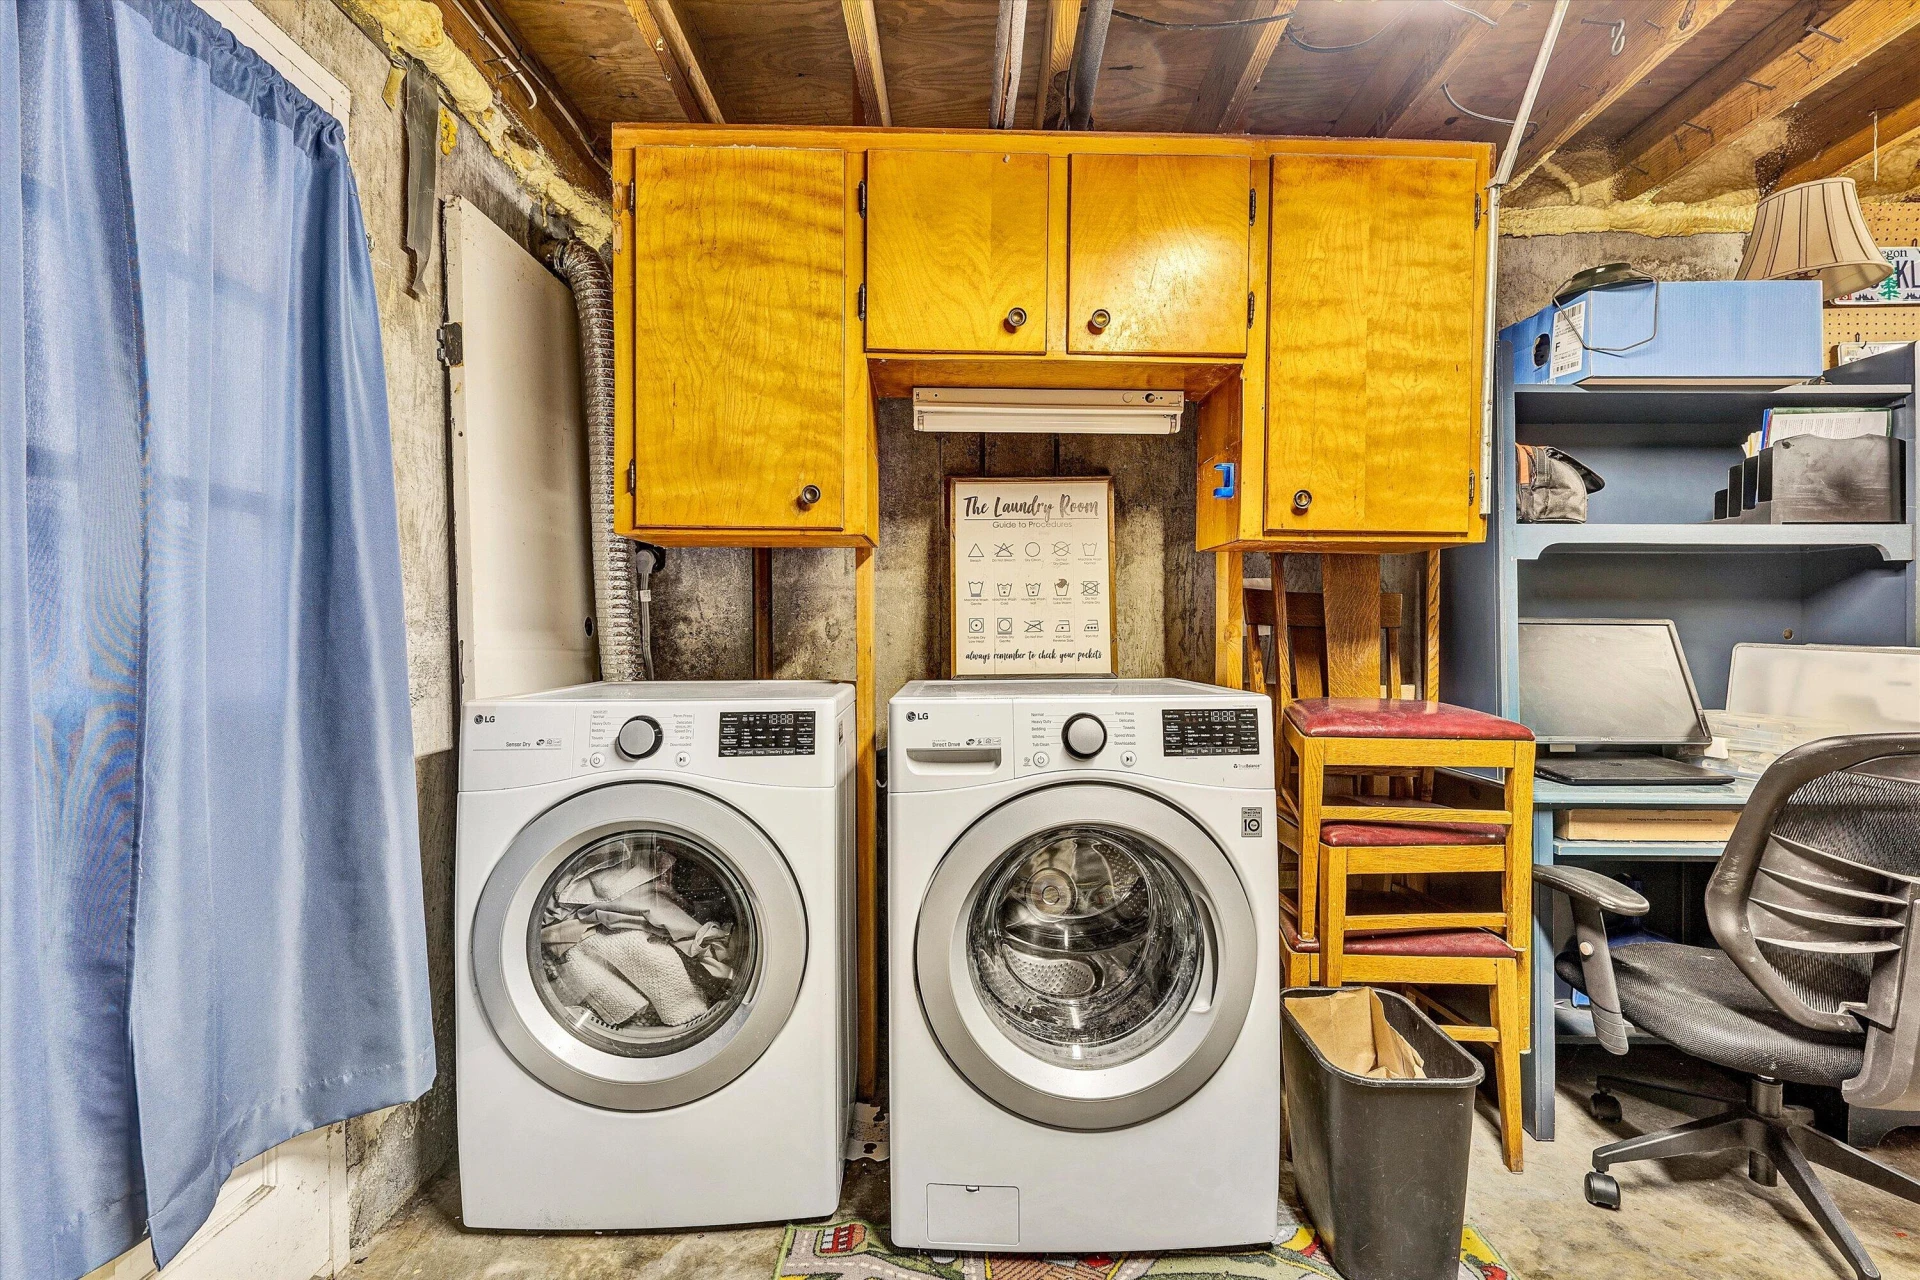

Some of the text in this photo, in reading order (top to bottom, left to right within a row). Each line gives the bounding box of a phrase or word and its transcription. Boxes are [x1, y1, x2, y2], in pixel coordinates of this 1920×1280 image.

[964, 494, 1098, 522] The Laundry Room
[992, 520, 1073, 529] Guide to Procedures
[966, 649, 1102, 664] always remember to check your pockets
[484, 715, 496, 723] LG
[917, 713, 929, 721] LG
[1244, 819, 1260, 832] 10
